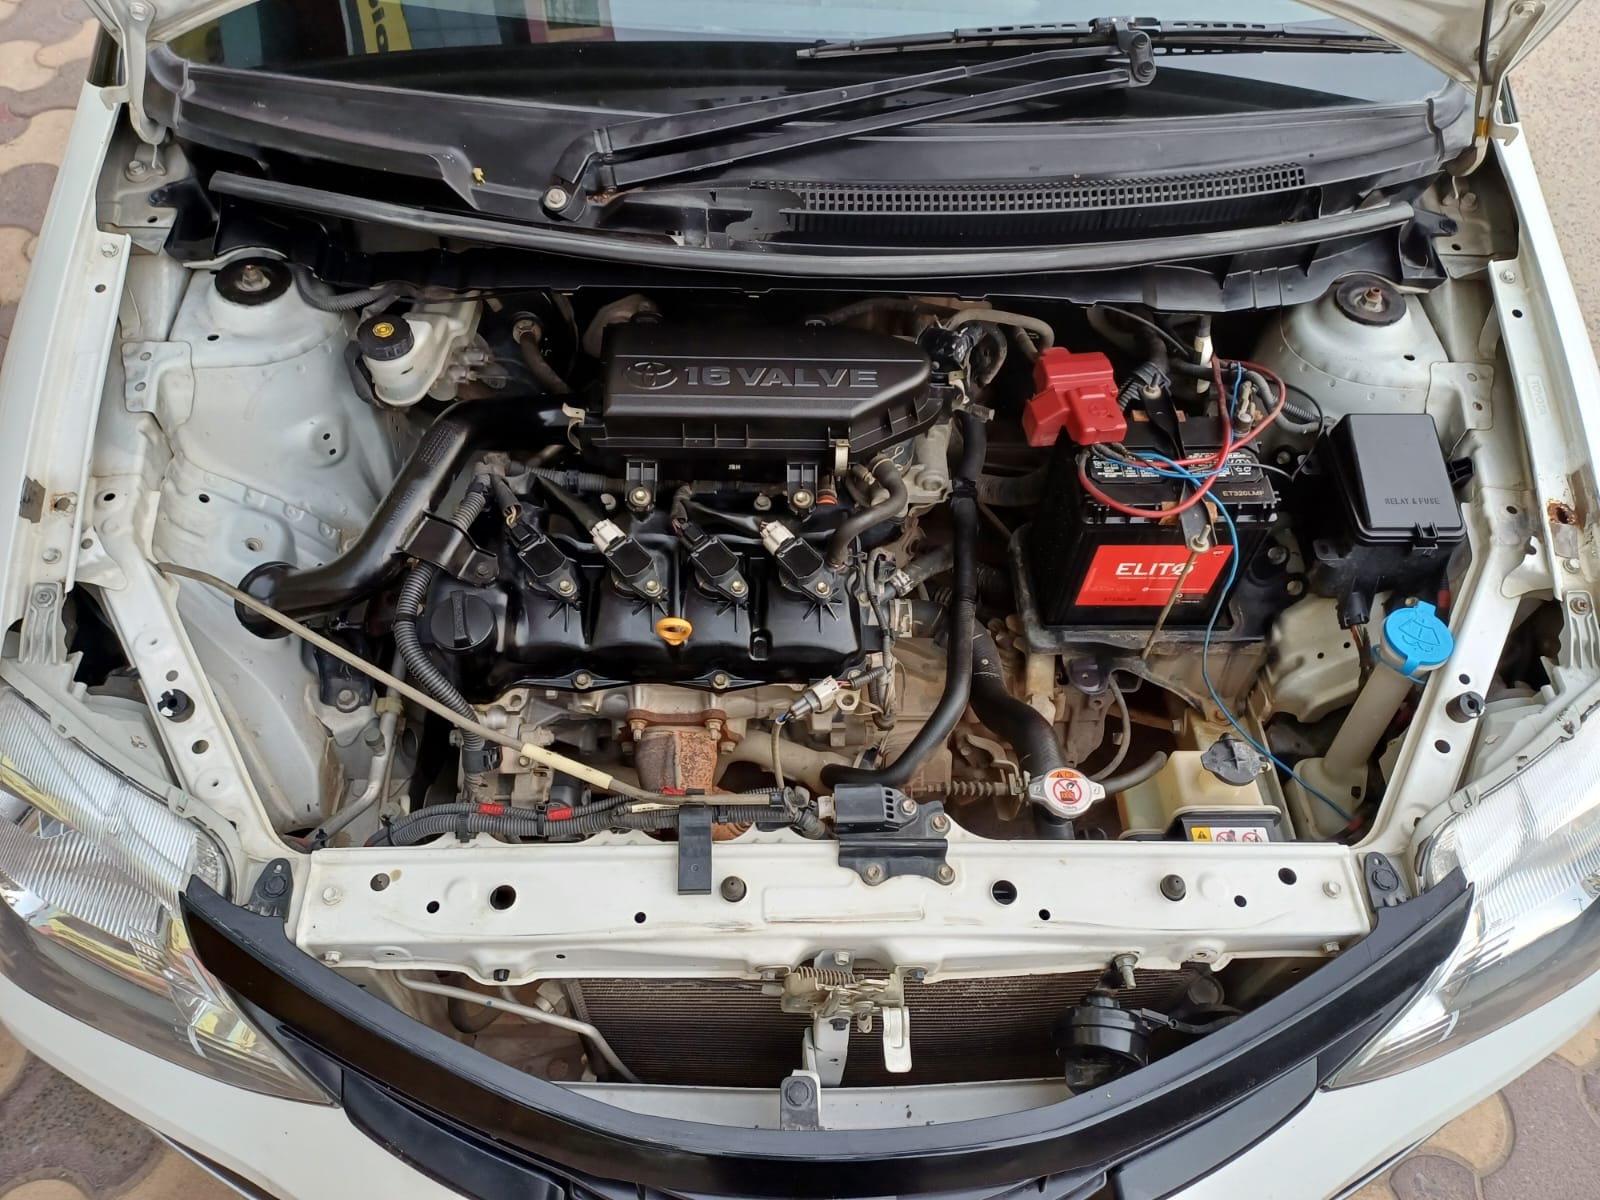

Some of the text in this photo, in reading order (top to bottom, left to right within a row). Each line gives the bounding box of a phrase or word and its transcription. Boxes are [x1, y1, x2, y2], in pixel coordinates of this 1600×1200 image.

[735, 367, 879, 388] VALVE
[1384, 497, 1409, 505] RELAY
[1418, 497, 1441, 505] FUSE
